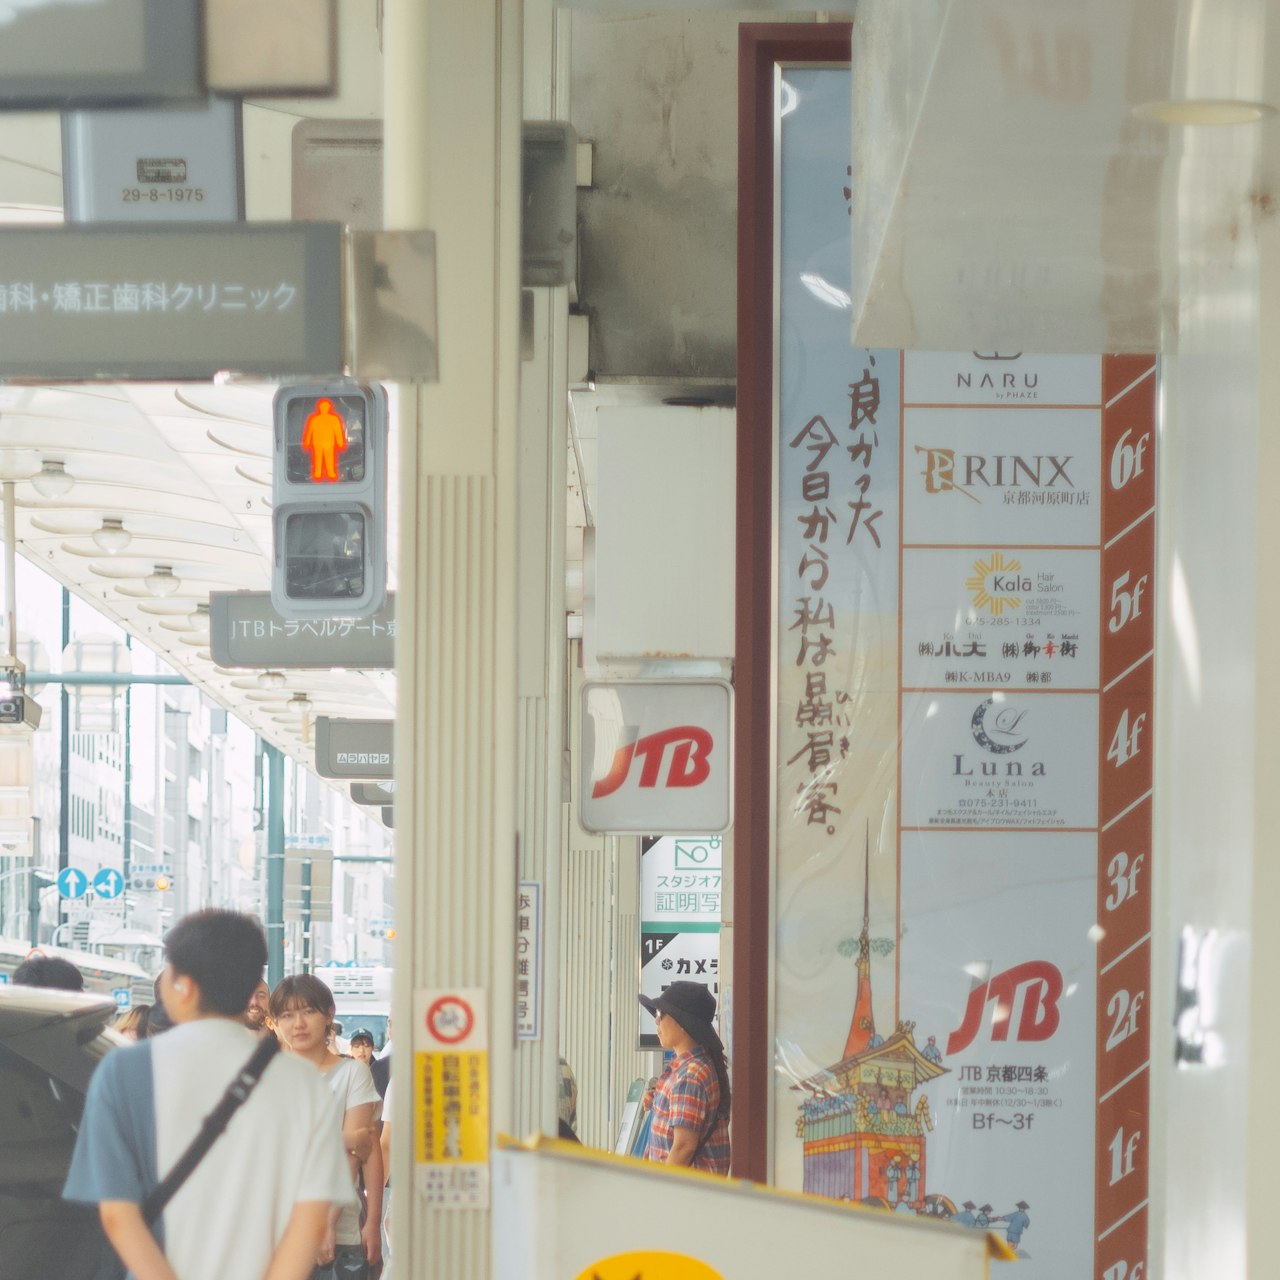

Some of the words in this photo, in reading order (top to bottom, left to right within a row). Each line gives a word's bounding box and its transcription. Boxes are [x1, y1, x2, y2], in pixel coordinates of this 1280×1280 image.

[122, 188, 204, 201] 29-8-1975
[957, 373, 1039, 389] NARU
[1006, 391, 1039, 399] PHAZE
[1109, 427, 1150, 491] 6f
[1003, 490, 1091, 506] 京都河原町店
[1037, 572, 1055, 582] Hair
[1037, 582, 1064, 593] Salon
[1108, 570, 1149, 634] 5f
[1106, 706, 1147, 769] 4f
[591, 725, 714, 799] JTB
[952, 754, 1047, 776] Luna
[964, 779, 1001, 788] Beauty
[1106, 851, 1144, 911] 3f
[645, 938, 664, 954] 1F
[946, 959, 1064, 1057] JTB
[1106, 988, 1144, 1053] 2f
[958, 1066, 983, 1081] JTB
[986, 1065, 1049, 1083] 京都四条
[1108, 1126, 1141, 1188] 1f
